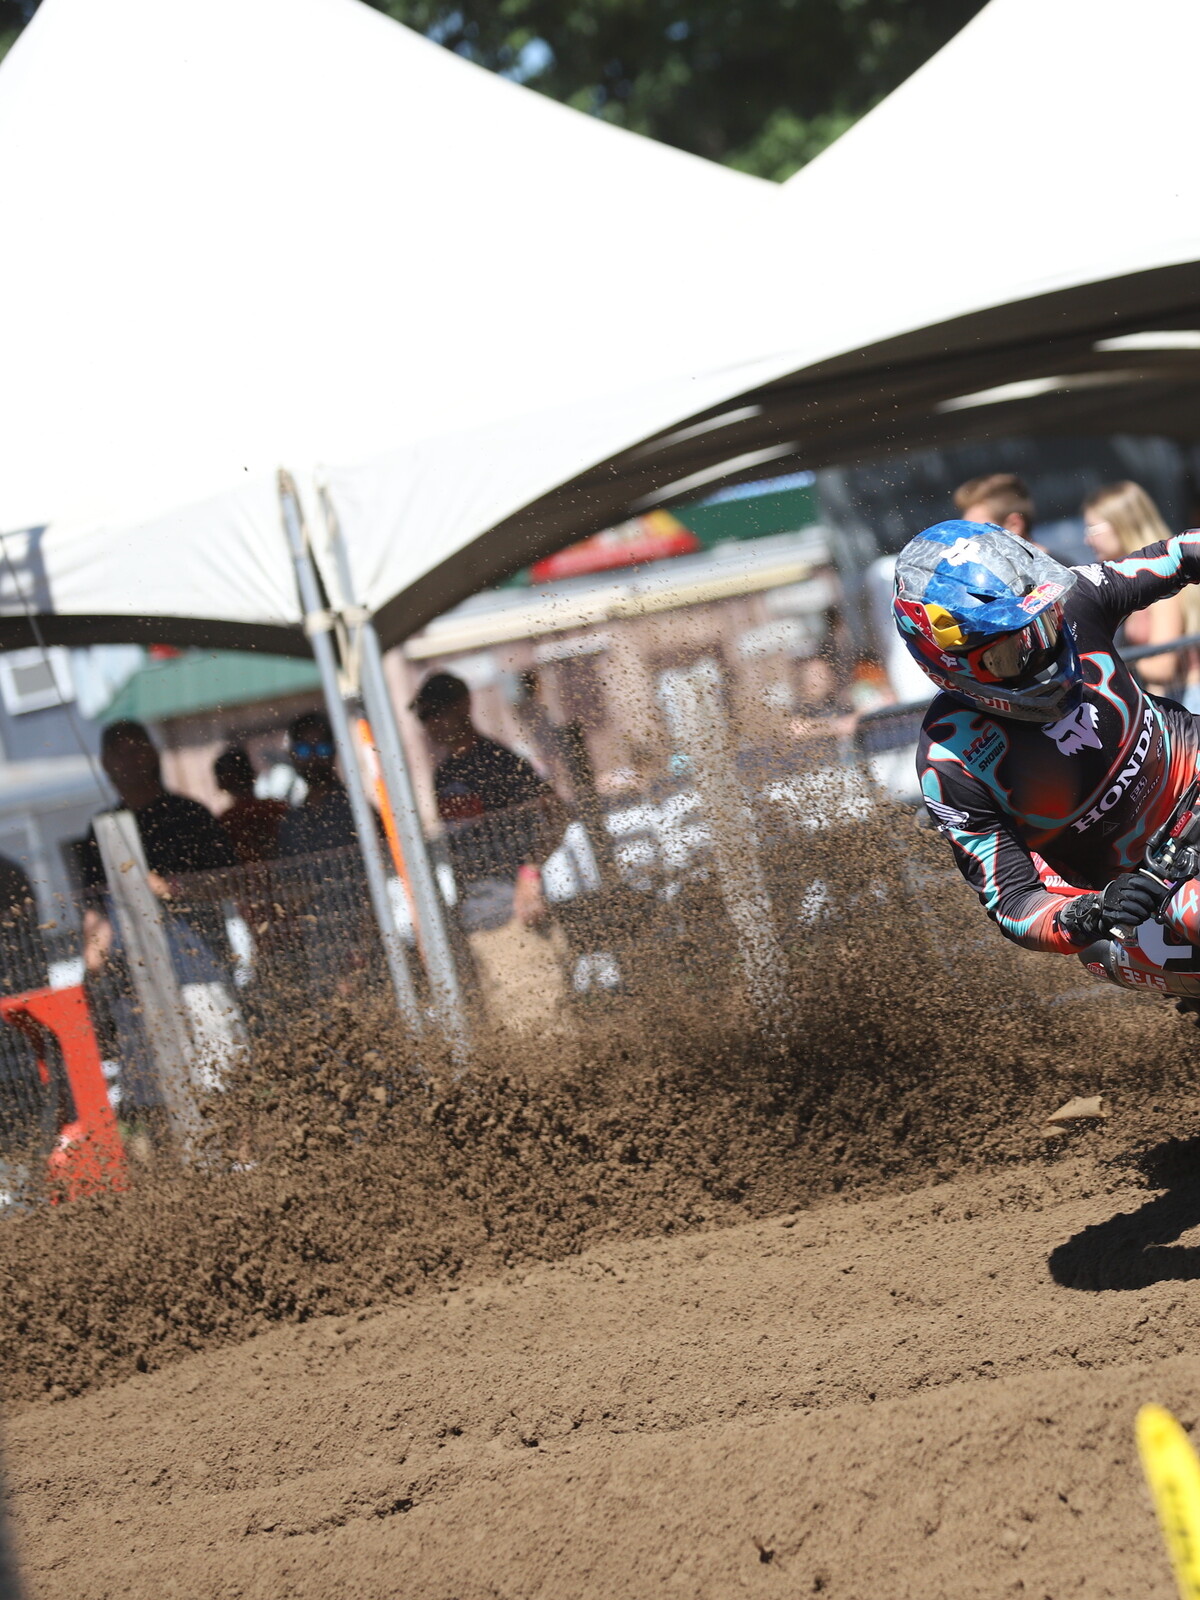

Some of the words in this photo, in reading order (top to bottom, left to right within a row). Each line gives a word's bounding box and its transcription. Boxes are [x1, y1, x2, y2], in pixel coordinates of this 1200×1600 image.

[962, 725, 1000, 762] HRC
[979, 741, 1005, 772] SHOWA
[1071, 708, 1154, 834] HONDA
